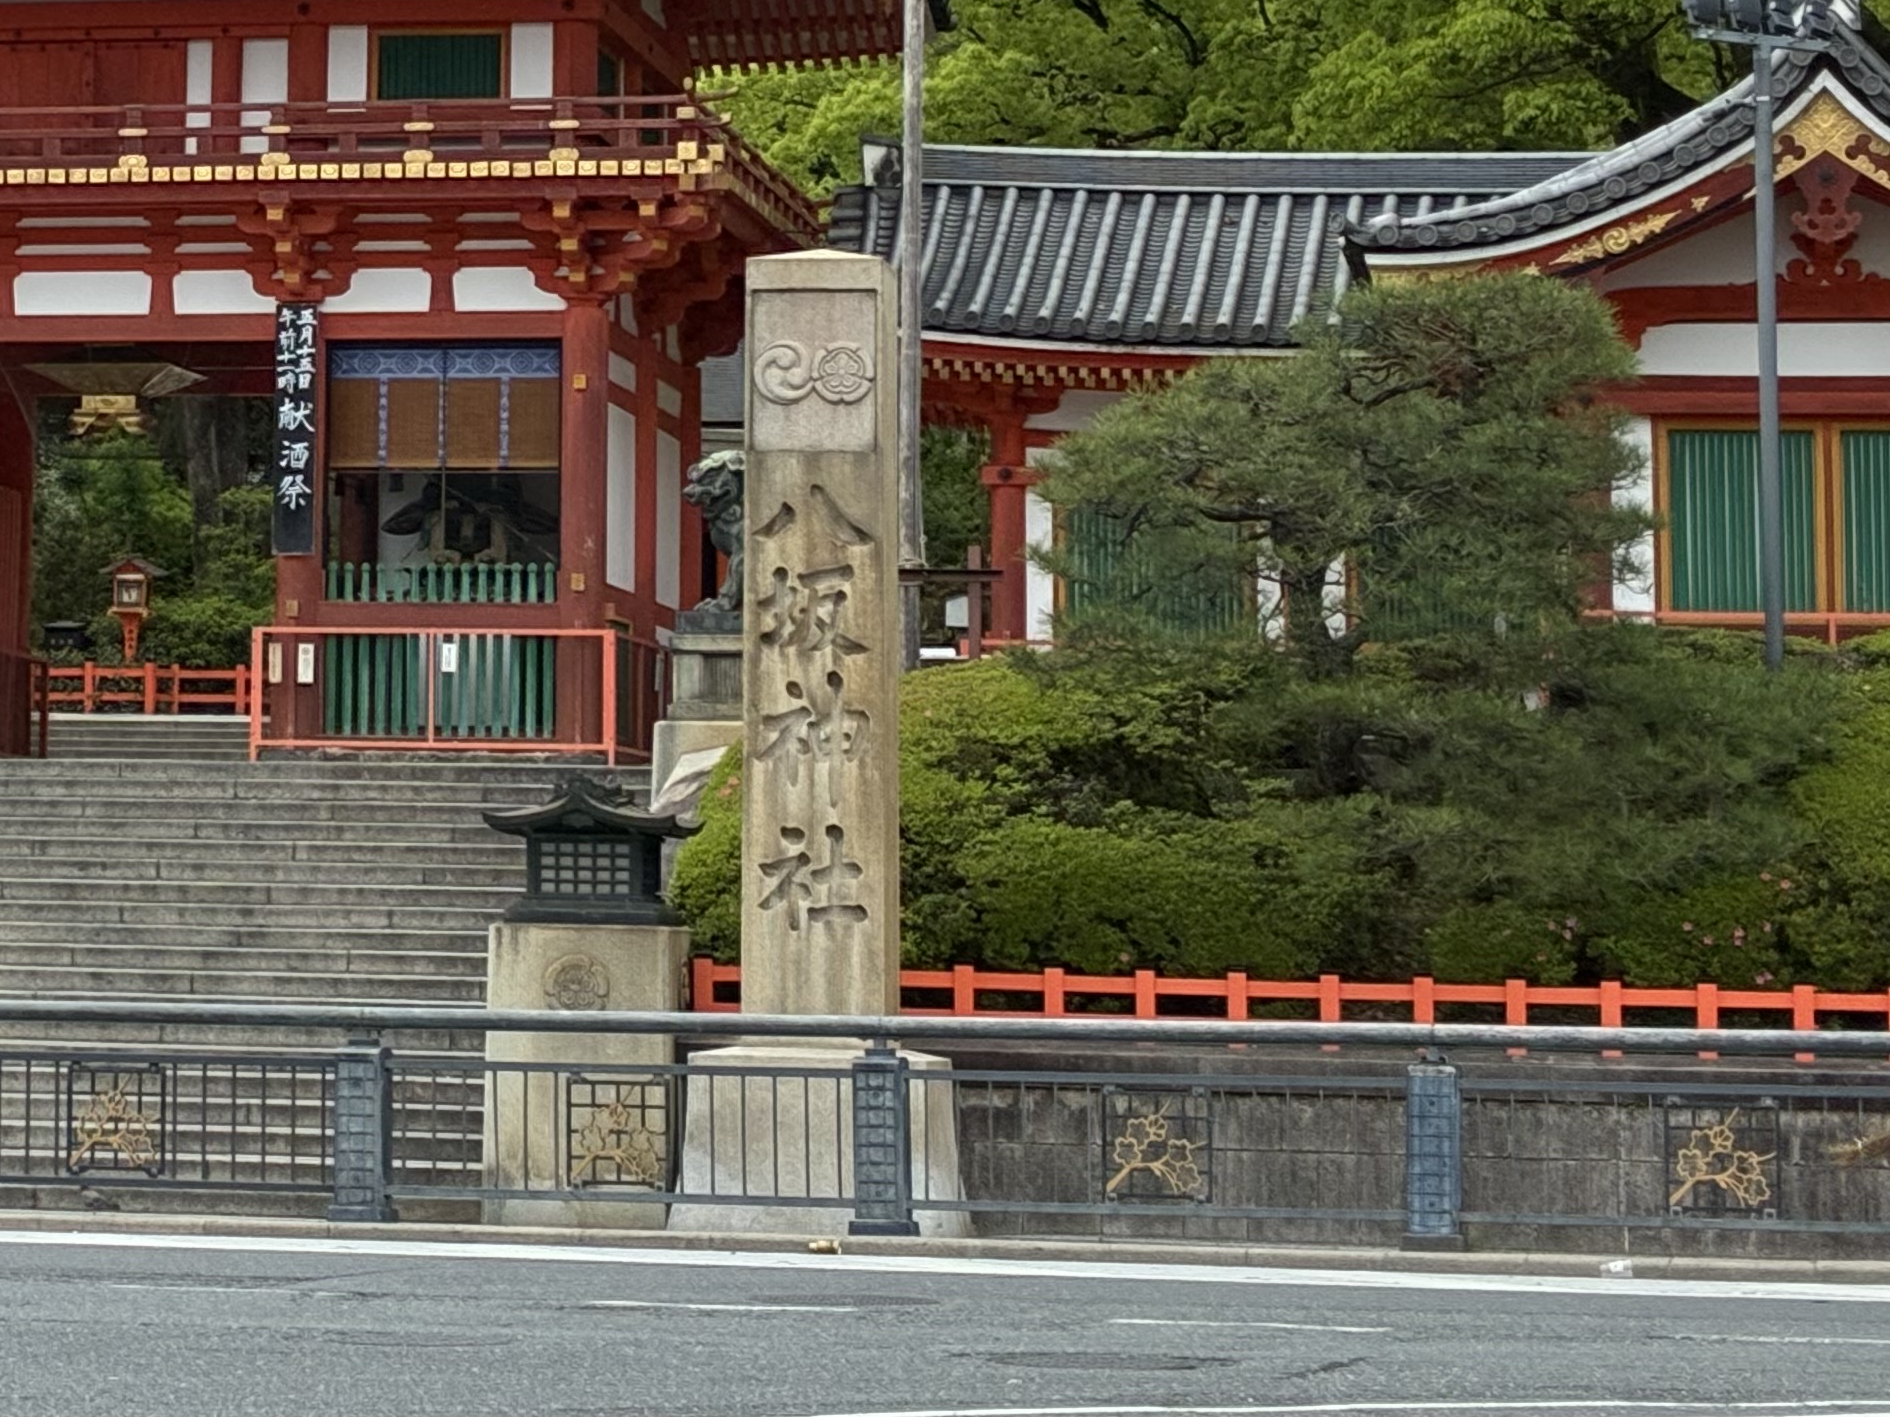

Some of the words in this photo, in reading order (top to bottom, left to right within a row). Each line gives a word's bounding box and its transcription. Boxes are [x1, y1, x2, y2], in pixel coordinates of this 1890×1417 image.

[276, 307, 297, 394] 午前十一時
[296, 307, 318, 390] 五月十五日
[277, 397, 316, 511] 献酒祭
[752, 483, 875, 932] 八坂神社
